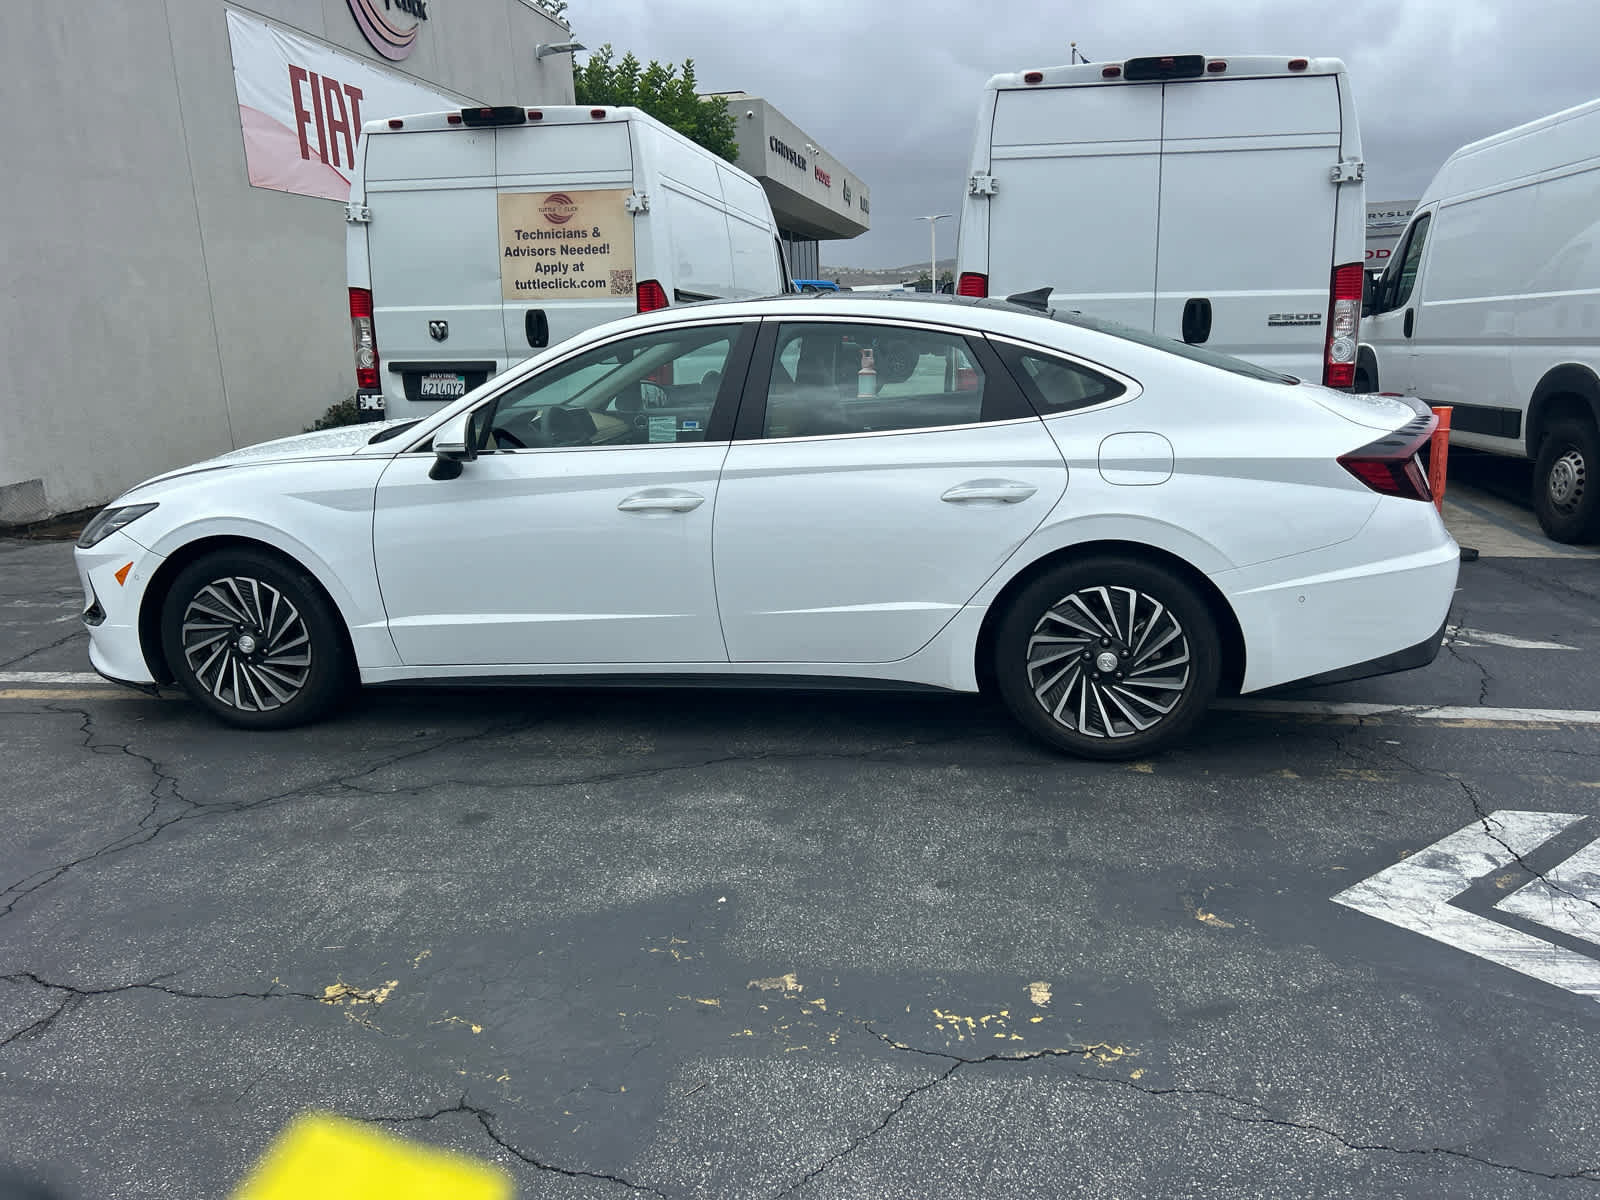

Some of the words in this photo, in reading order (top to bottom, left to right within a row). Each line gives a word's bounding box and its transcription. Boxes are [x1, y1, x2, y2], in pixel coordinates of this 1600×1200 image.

[288, 64, 363, 170] FIAT
[769, 135, 807, 172] CHRYSLER
[514, 228, 588, 240] Technicians
[591, 227, 601, 238] &
[504, 246, 557, 257] Advisors
[560, 243, 610, 256] Needed!
[535, 261, 569, 275] Apply
[572, 262, 585, 272] at
[514, 278, 607, 290] tuttleclick.com
